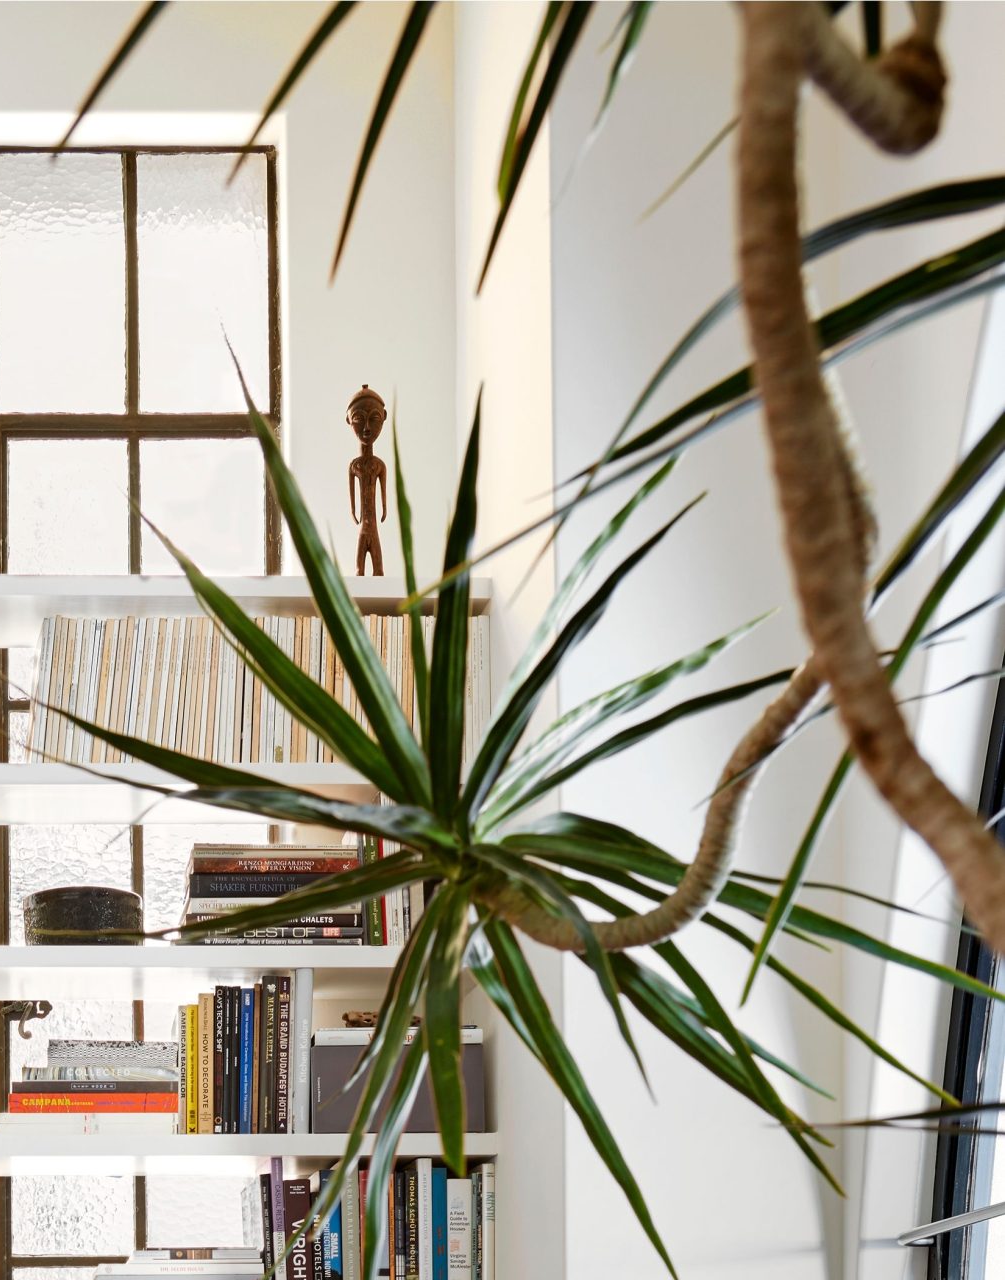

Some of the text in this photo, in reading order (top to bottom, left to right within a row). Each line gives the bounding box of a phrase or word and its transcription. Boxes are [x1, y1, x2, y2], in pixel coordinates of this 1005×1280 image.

[210, 883, 246, 892] SHAKER
[300, 916, 334, 924] CHALETS
[292, 927, 316, 937] OF
[202, 1054, 208, 1065] TO
[278, 1004, 288, 1121] THE GRAND BUDAPEST HOTEL
[22, 1098, 71, 1106] CAMPANA
[314, 1237, 322, 1271] HOTELS
